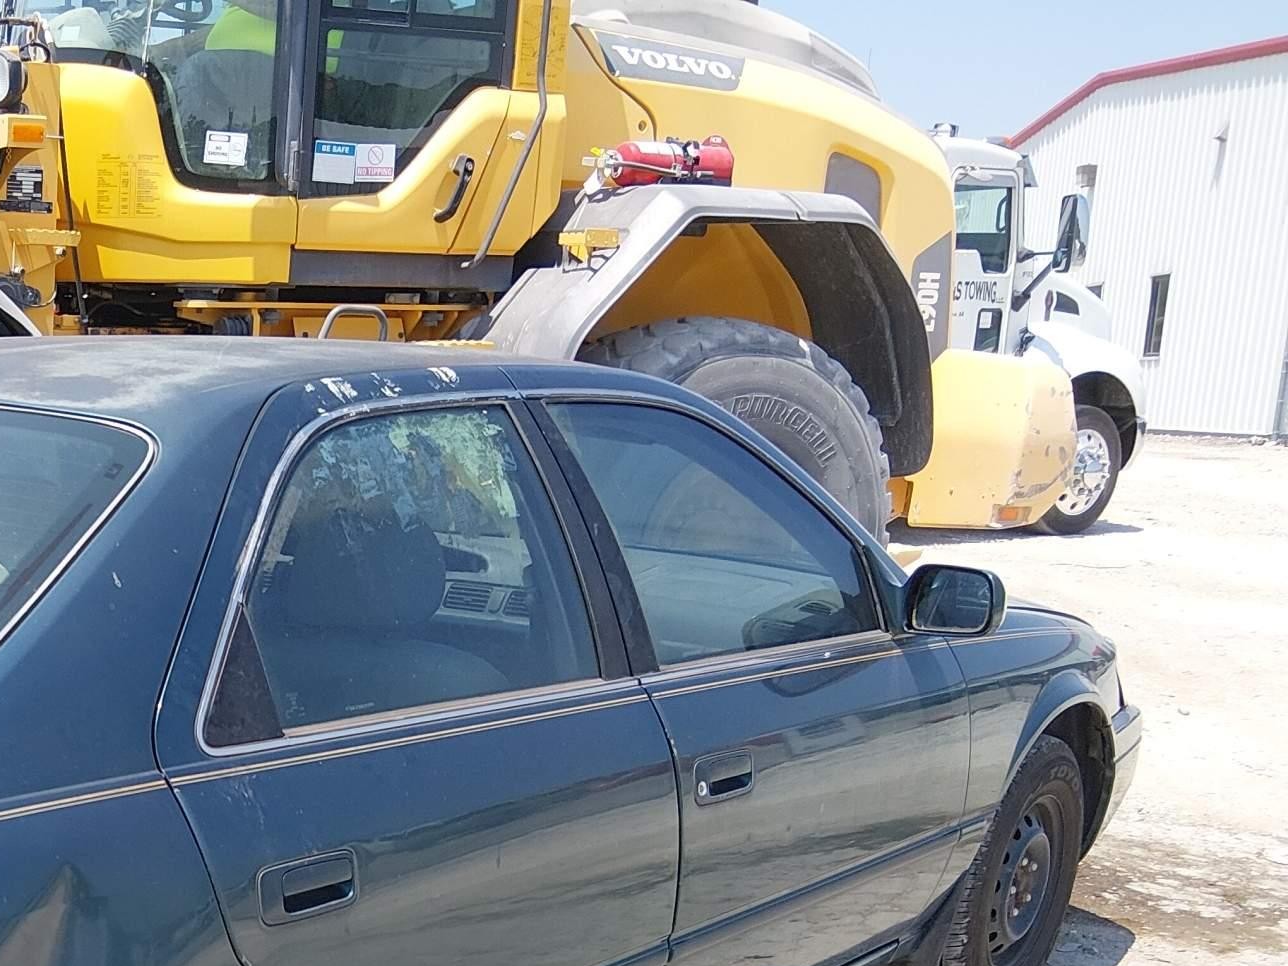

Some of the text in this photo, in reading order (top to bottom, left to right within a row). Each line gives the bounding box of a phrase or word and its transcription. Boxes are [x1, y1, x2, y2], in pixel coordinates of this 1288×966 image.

[612, 45, 733, 80] VOLVO
[321, 144, 350, 153] BE SAFE
[357, 167, 392, 176] NO TIPPING
[964, 280, 998, 304] TOWING
